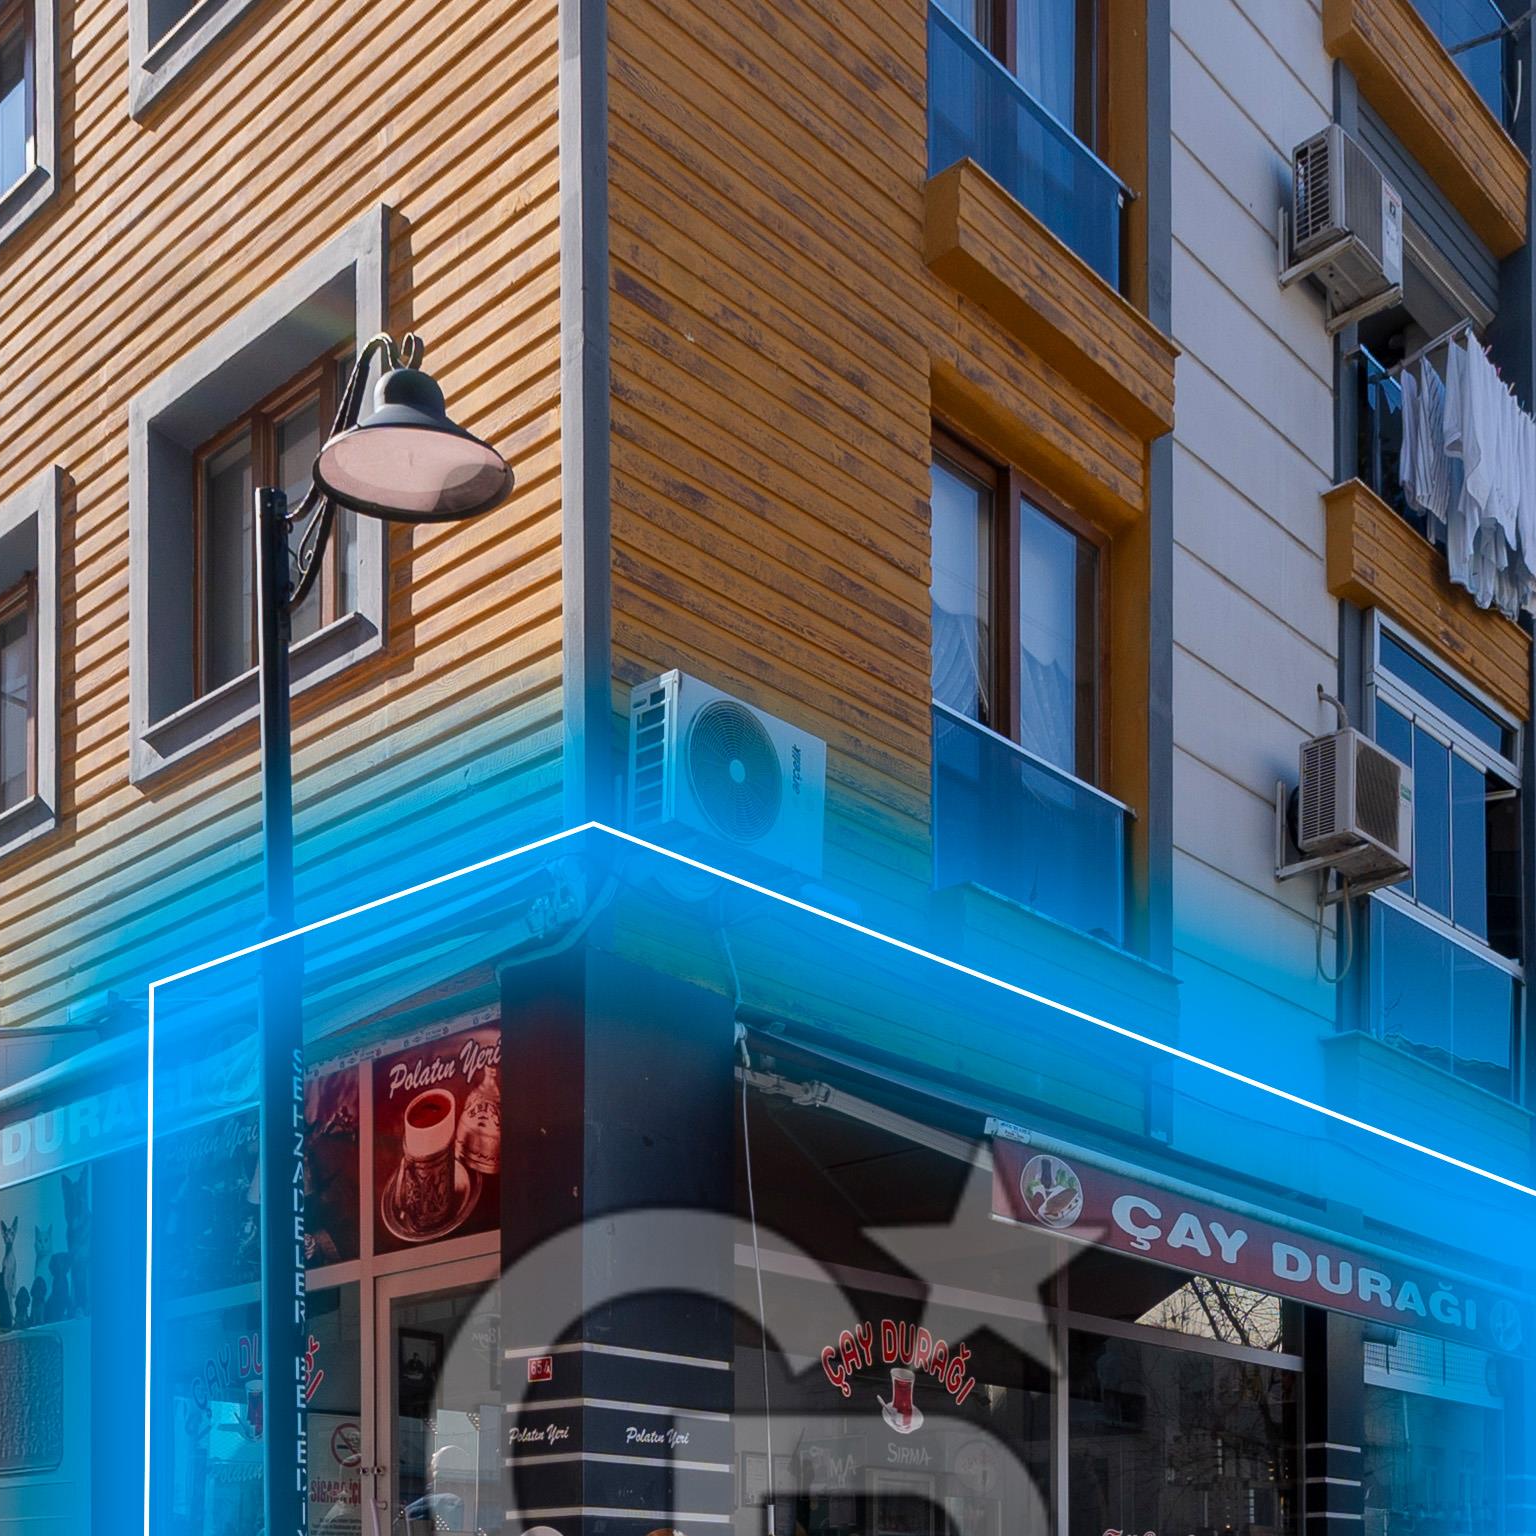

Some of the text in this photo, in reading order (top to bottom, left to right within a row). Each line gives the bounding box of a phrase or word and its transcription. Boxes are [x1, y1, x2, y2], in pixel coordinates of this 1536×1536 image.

[389, 1034, 501, 1099] Polatın Yeri
[1112, 1195, 1478, 1331] ÇAY DURAĞI
[191, 1344, 231, 1418] ÇAY
[821, 1319, 976, 1406] ÇAY DURAĞI
[509, 1423, 569, 1446] Polatın Yeri
[625, 1427, 691, 1449] Polatın Yeri
